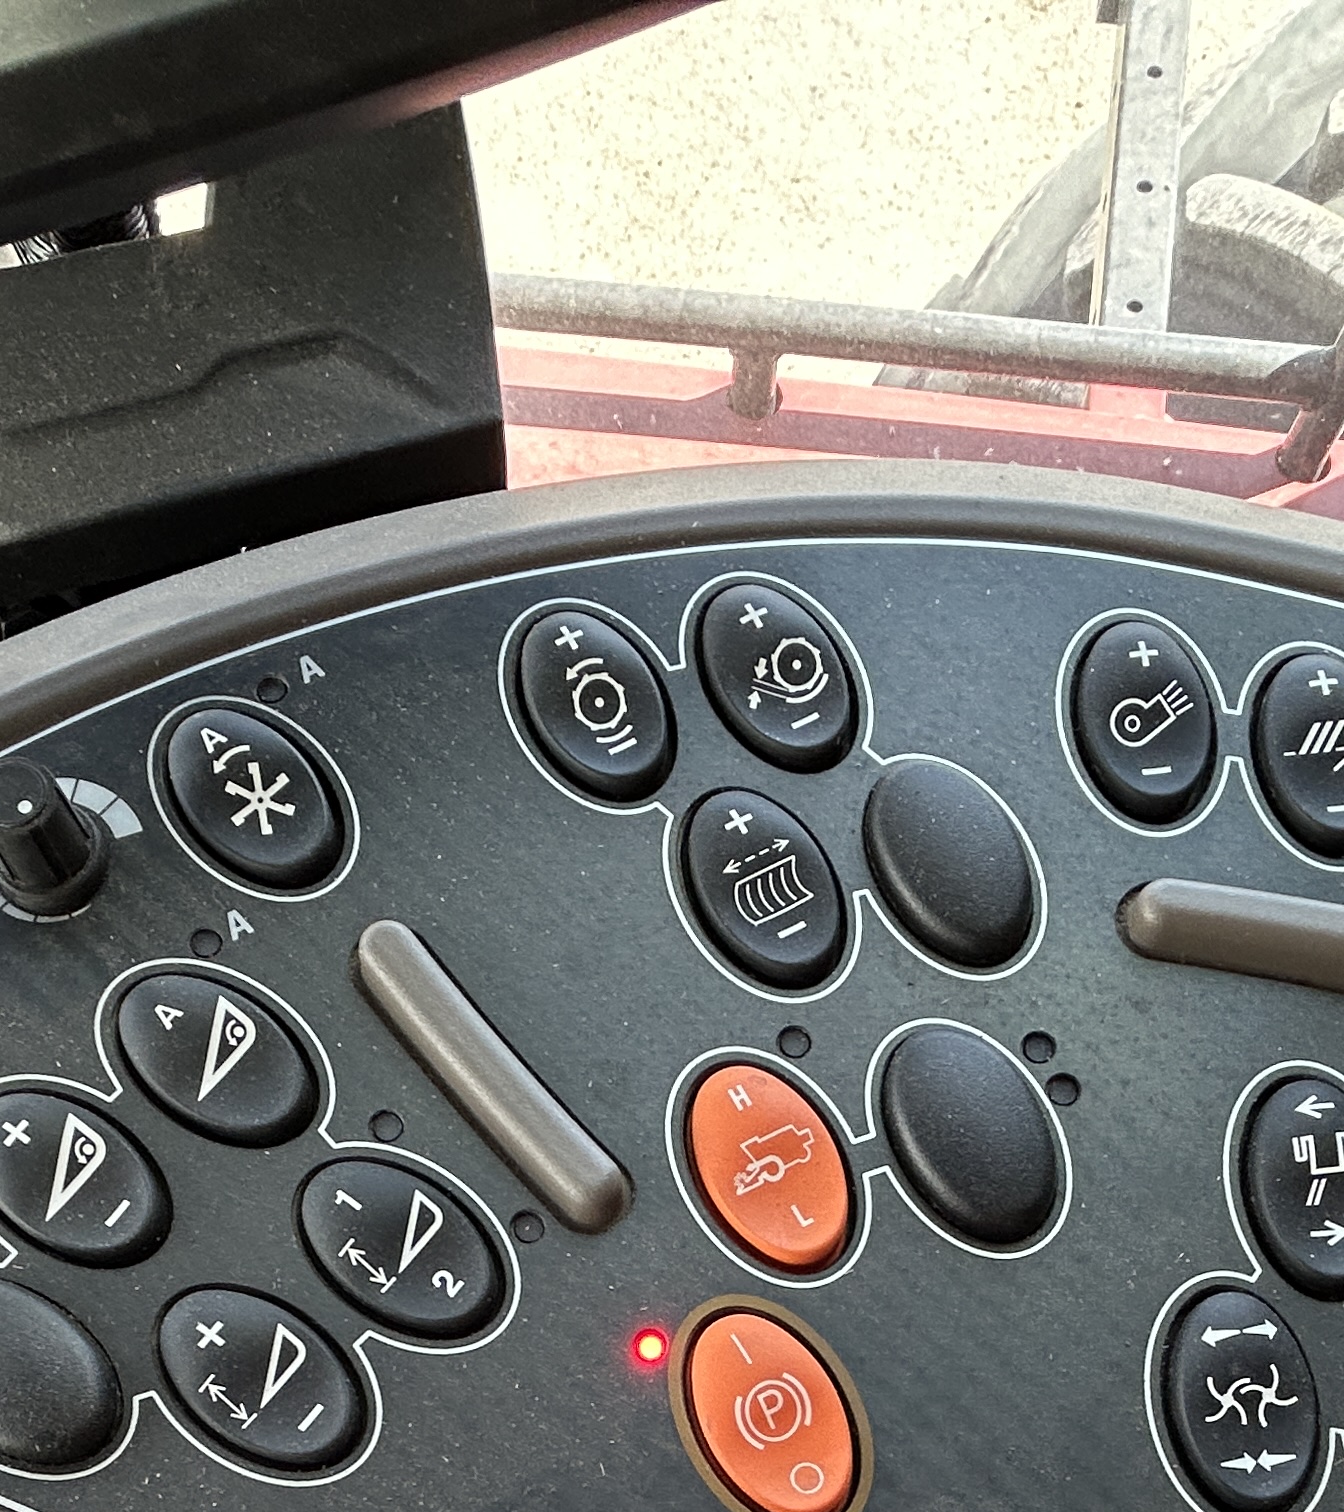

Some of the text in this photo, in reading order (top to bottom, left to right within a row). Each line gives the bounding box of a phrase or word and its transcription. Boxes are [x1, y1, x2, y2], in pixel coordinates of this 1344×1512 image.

[299, 655, 326, 684] A
[200, 727, 228, 753] A
[228, 909, 255, 941] A
[154, 1004, 184, 1030] A
[728, 1084, 753, 1111] H
[333, 1189, 363, 1211] 1
[790, 1204, 815, 1228] L
[430, 1269, 466, 1298] 2
[755, 1389, 785, 1430] P
